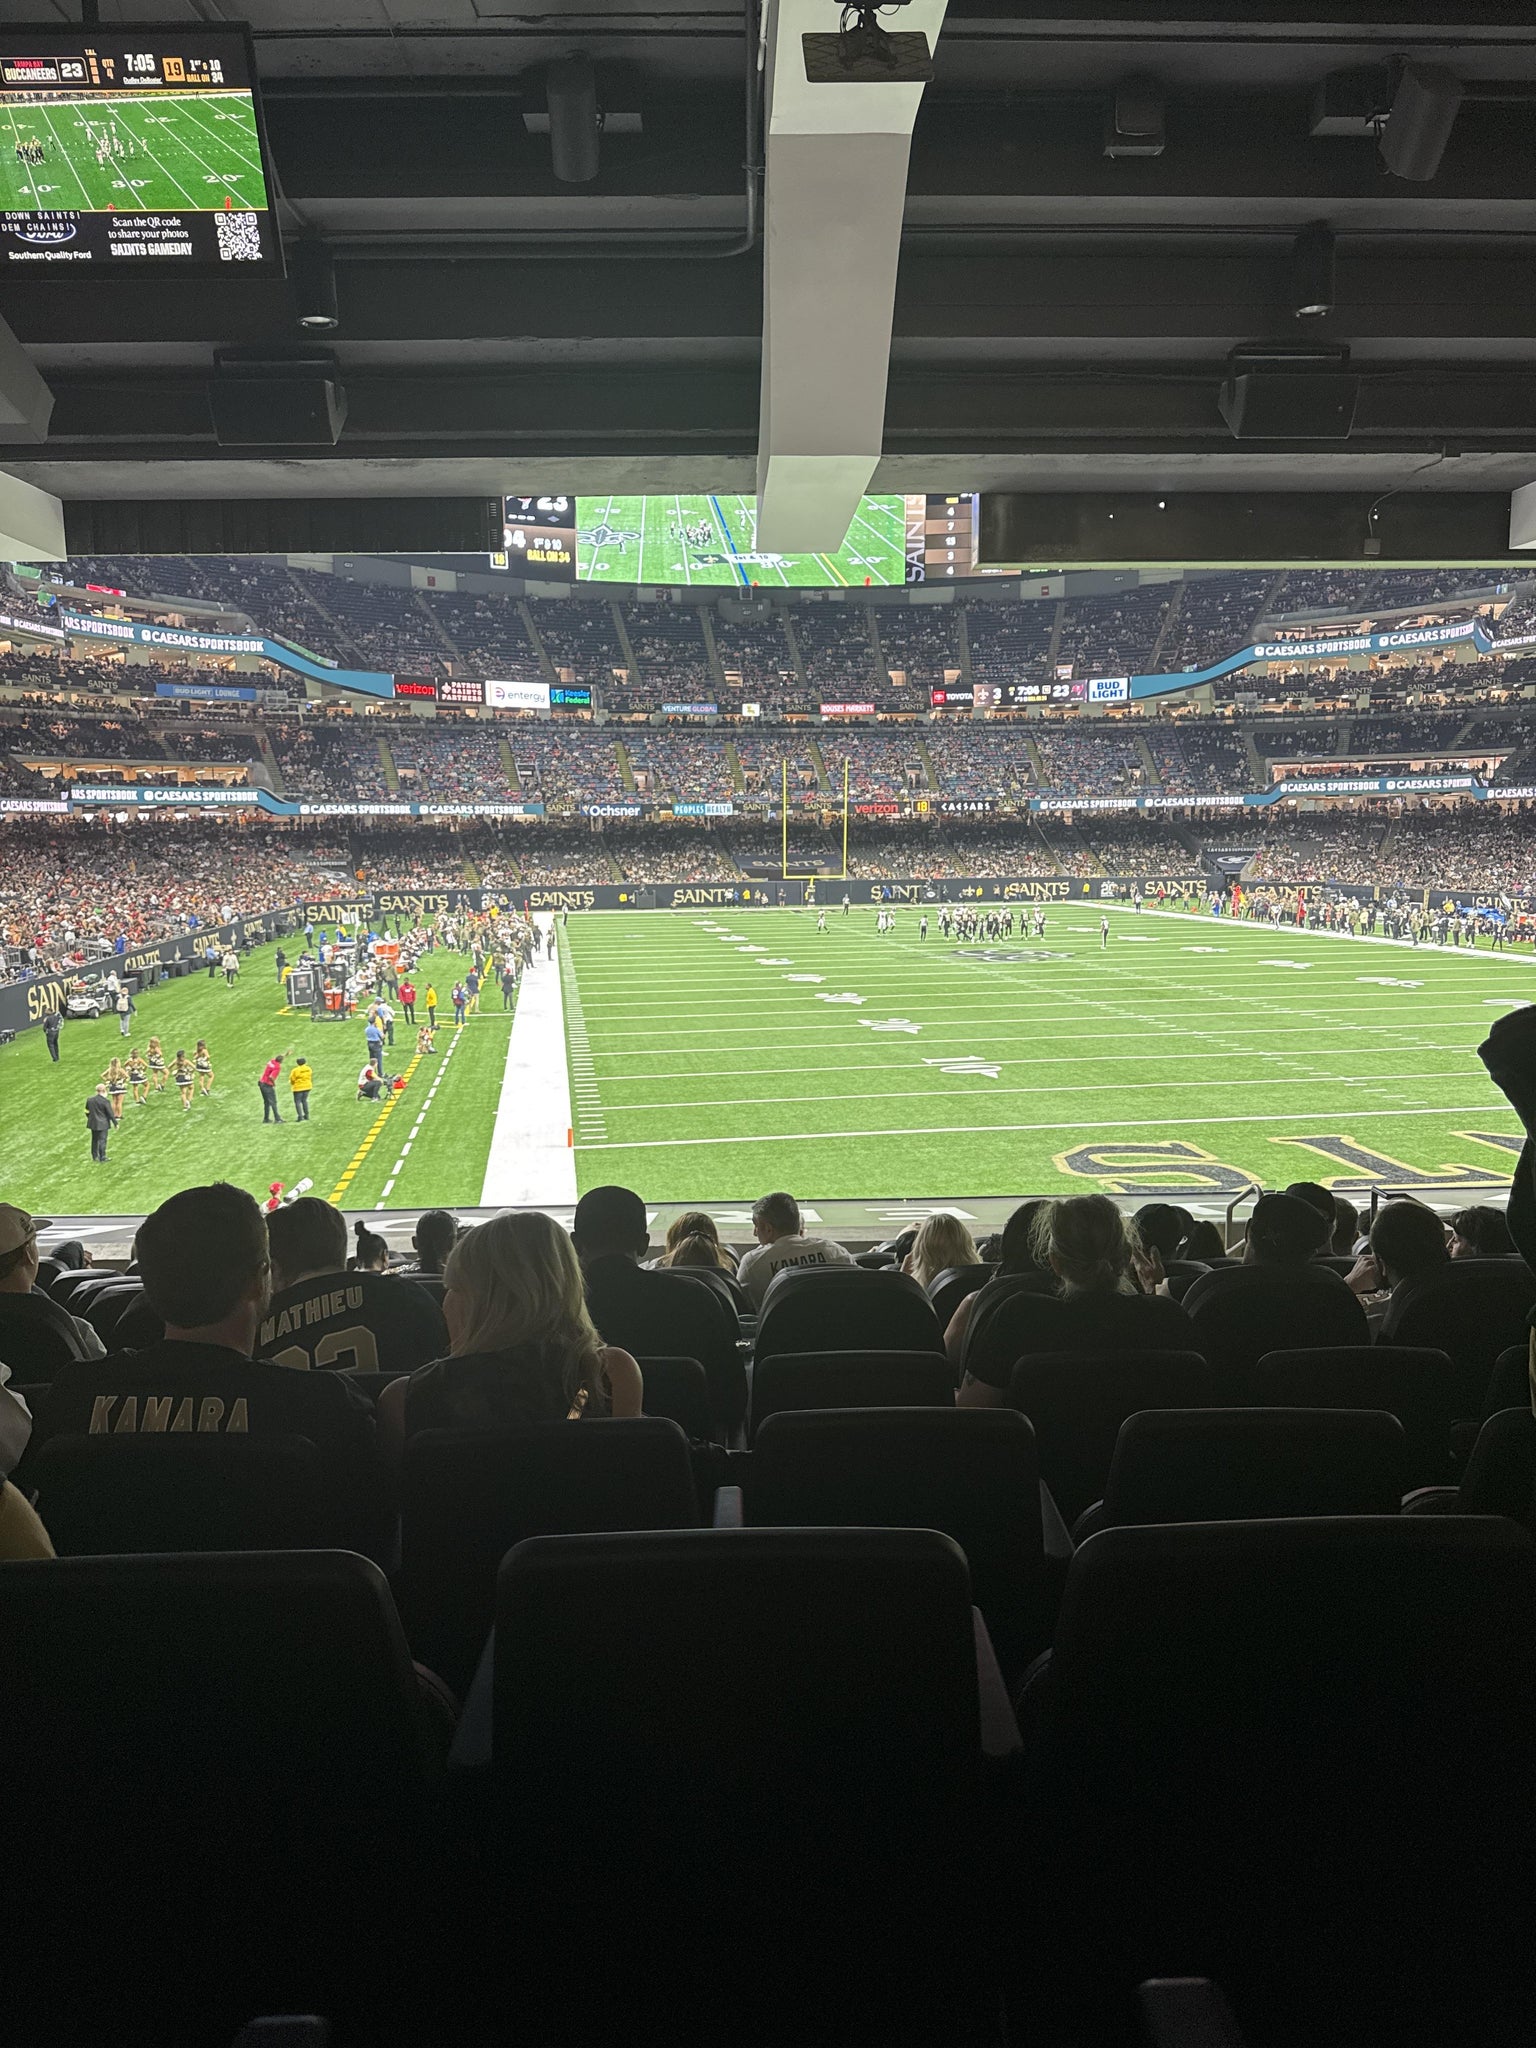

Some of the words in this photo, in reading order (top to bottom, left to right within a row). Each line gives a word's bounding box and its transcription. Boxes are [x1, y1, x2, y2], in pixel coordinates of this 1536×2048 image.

[124, 53, 156, 72] 7:05
[209, 59, 221, 71] 10
[4, 68, 58, 81] BUCCANEERS
[60, 63, 84, 78] 23
[165, 62, 182, 76] 19
[186, 73, 201, 83] BALL
[200, 73, 211, 83] ON
[211, 71, 224, 84] 34
[5, 212, 31, 220] DOWN
[1, 223, 21, 231] DEM
[112, 217, 135, 226] Scan
[135, 217, 148, 226] the
[147, 217, 162, 227] QR
[162, 217, 182, 226] code
[108, 230, 117, 238] to
[117, 229, 139, 239] share
[139, 231, 161, 240] your
[161, 229, 189, 239] photos
[110, 243, 147, 256] SAINTS
[147, 243, 193, 256] GAMEDAY
[9, 251, 45, 260] Southern
[45, 251, 73, 261] Quality
[73, 251, 92, 260] Ford
[526, 549, 546, 562] BALL
[546, 551, 558, 562] ON
[80, 620, 135, 639] SPORTSBOOK
[151, 630, 199, 648] CAESARS
[199, 637, 265, 652] SPORTSBOOK
[1389, 631, 1439, 646] CAESARS
[1496, 637, 1522, 648] CAESARS
[1265, 643, 1315, 656] CAESARS
[1315, 638, 1372, 653] SPORTSBOOK
[22, 673, 52, 684] SAINTS
[1472, 677, 1503, 687] SAINTS
[87, 680, 119, 690] SAINTS
[395, 682, 435, 695] verizon
[451, 681, 482, 689] PATRON
[1096, 681, 1121, 691] BUD
[1407, 682, 1437, 692] SAINTS
[174, 687, 190, 695] BUD
[190, 688, 212, 696] LIGHT
[214, 688, 241, 698] LOUNGE
[451, 688, 482, 696] SAINTS
[992, 688, 1002, 700] 3
[1052, 685, 1070, 697] 23
[1092, 689, 1125, 700] LIGHT
[1279, 690, 1309, 699] SAINTS
[1343, 686, 1373, 696] SAINTS
[441, 694, 483, 702] PARTNERS
[507, 691, 546, 703] entergy
[628, 703, 655, 711] SAINTS
[662, 704, 692, 713] VENTURE
[692, 704, 717, 713] GLOBAL
[786, 704, 812, 712] SAINTS
[820, 704, 845, 713] ROUSES
[845, 704, 875, 713] MARKETS
[900, 703, 925, 711] SAINTS
[1287, 782, 1327, 792] CAESARS
[1327, 781, 1380, 791] SPORTSBOOK
[1396, 779, 1442, 790] CAESARS
[86, 789, 138, 800] SPORTSBOOK
[154, 790, 202, 801] CAESARS
[202, 791, 259, 802] SPORTSBOOK
[1494, 787, 1534, 798] CAESARS
[0, 800, 33, 812] CAESARS
[742, 803, 771, 811] SAINTS
[804, 802, 832, 810] SAINTS
[916, 801, 927, 812] 18
[941, 801, 991, 812] CAESARS
[998, 799, 1026, 808] SAINTS
[1048, 800, 1090, 809] CAESARS
[1090, 799, 1137, 808] SPORTSBOOK
[1154, 798, 1196, 807] CAESARS
[1196, 796, 1245, 806] SPORTSBOOK
[310, 804, 358, 815] CAESARS
[358, 804, 411, 815] SPORTSBOOK
[429, 804, 474, 815] CAESARS
[474, 804, 524, 815] SPORTSBOOK
[546, 804, 576, 812] SAINTS
[589, 804, 641, 817] Ochsner
[674, 804, 705, 815] PEOPLES
[705, 804, 732, 815] HEALTH
[854, 803, 899, 814] verizon
[752, 859, 826, 869] SAINTS
[870, 884, 920, 899] SAINT
[1009, 881, 1071, 896] SAINTS
[1144, 879, 1208, 896] SAINTS
[529, 890, 595, 907] SAINTS
[673, 887, 736, 905] SAINTS
[379, 894, 449, 912] SAINTS
[306, 903, 374, 923] SAINTS
[921, 1055, 1003, 1079] 10
[260, 1285, 364, 1347] MATHIEU
[88, 1395, 249, 1435] KAMARA
